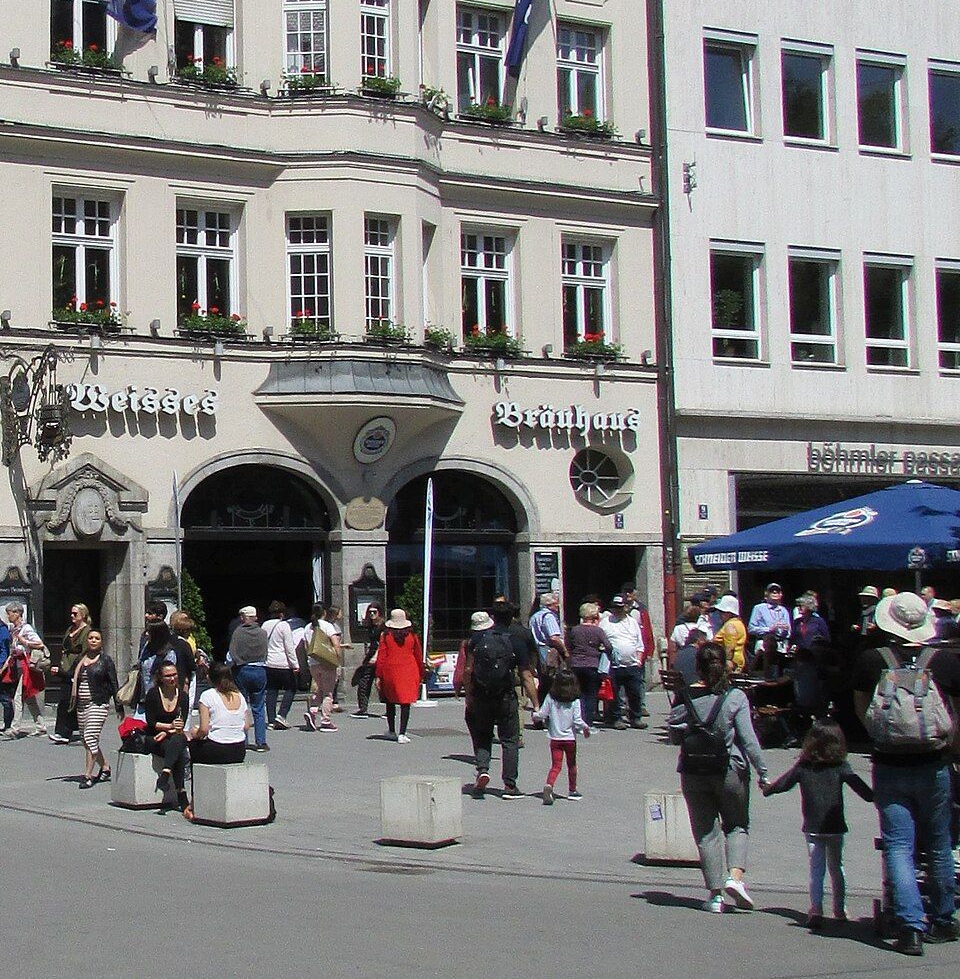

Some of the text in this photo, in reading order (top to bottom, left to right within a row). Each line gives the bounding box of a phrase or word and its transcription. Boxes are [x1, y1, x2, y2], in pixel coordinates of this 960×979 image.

[66, 383, 218, 416] Weisses
[495, 402, 640, 436] Bräuhaus
[695, 550, 768, 565] SCHNEIDER WEISSE
